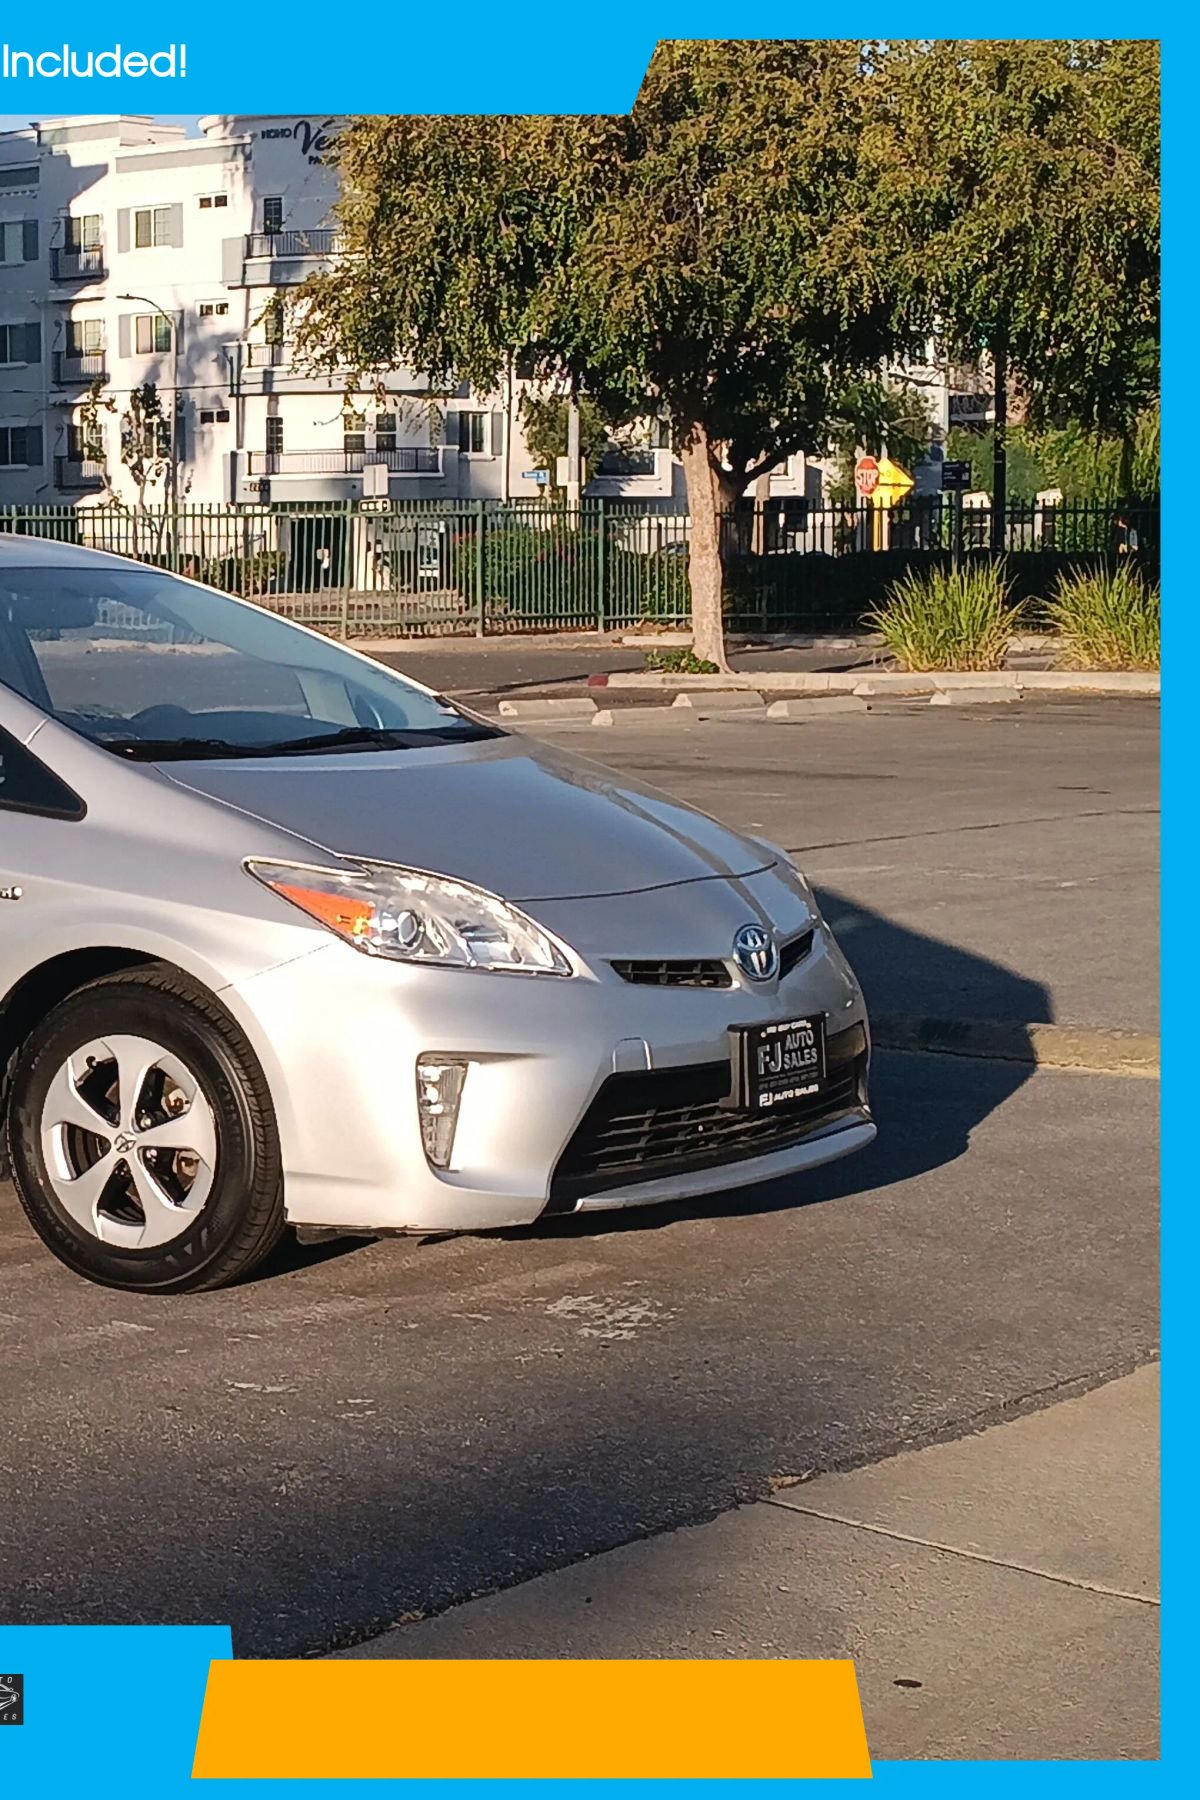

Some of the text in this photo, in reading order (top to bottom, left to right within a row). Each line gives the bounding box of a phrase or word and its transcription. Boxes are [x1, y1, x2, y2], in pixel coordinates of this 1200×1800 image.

[856, 469, 879, 486] STOP
[757, 1029, 814, 1075] FJ AUTO
[783, 1047, 818, 1070] SALES
[759, 1092, 774, 1107] FJ
[774, 1089, 794, 1102] AUTO
